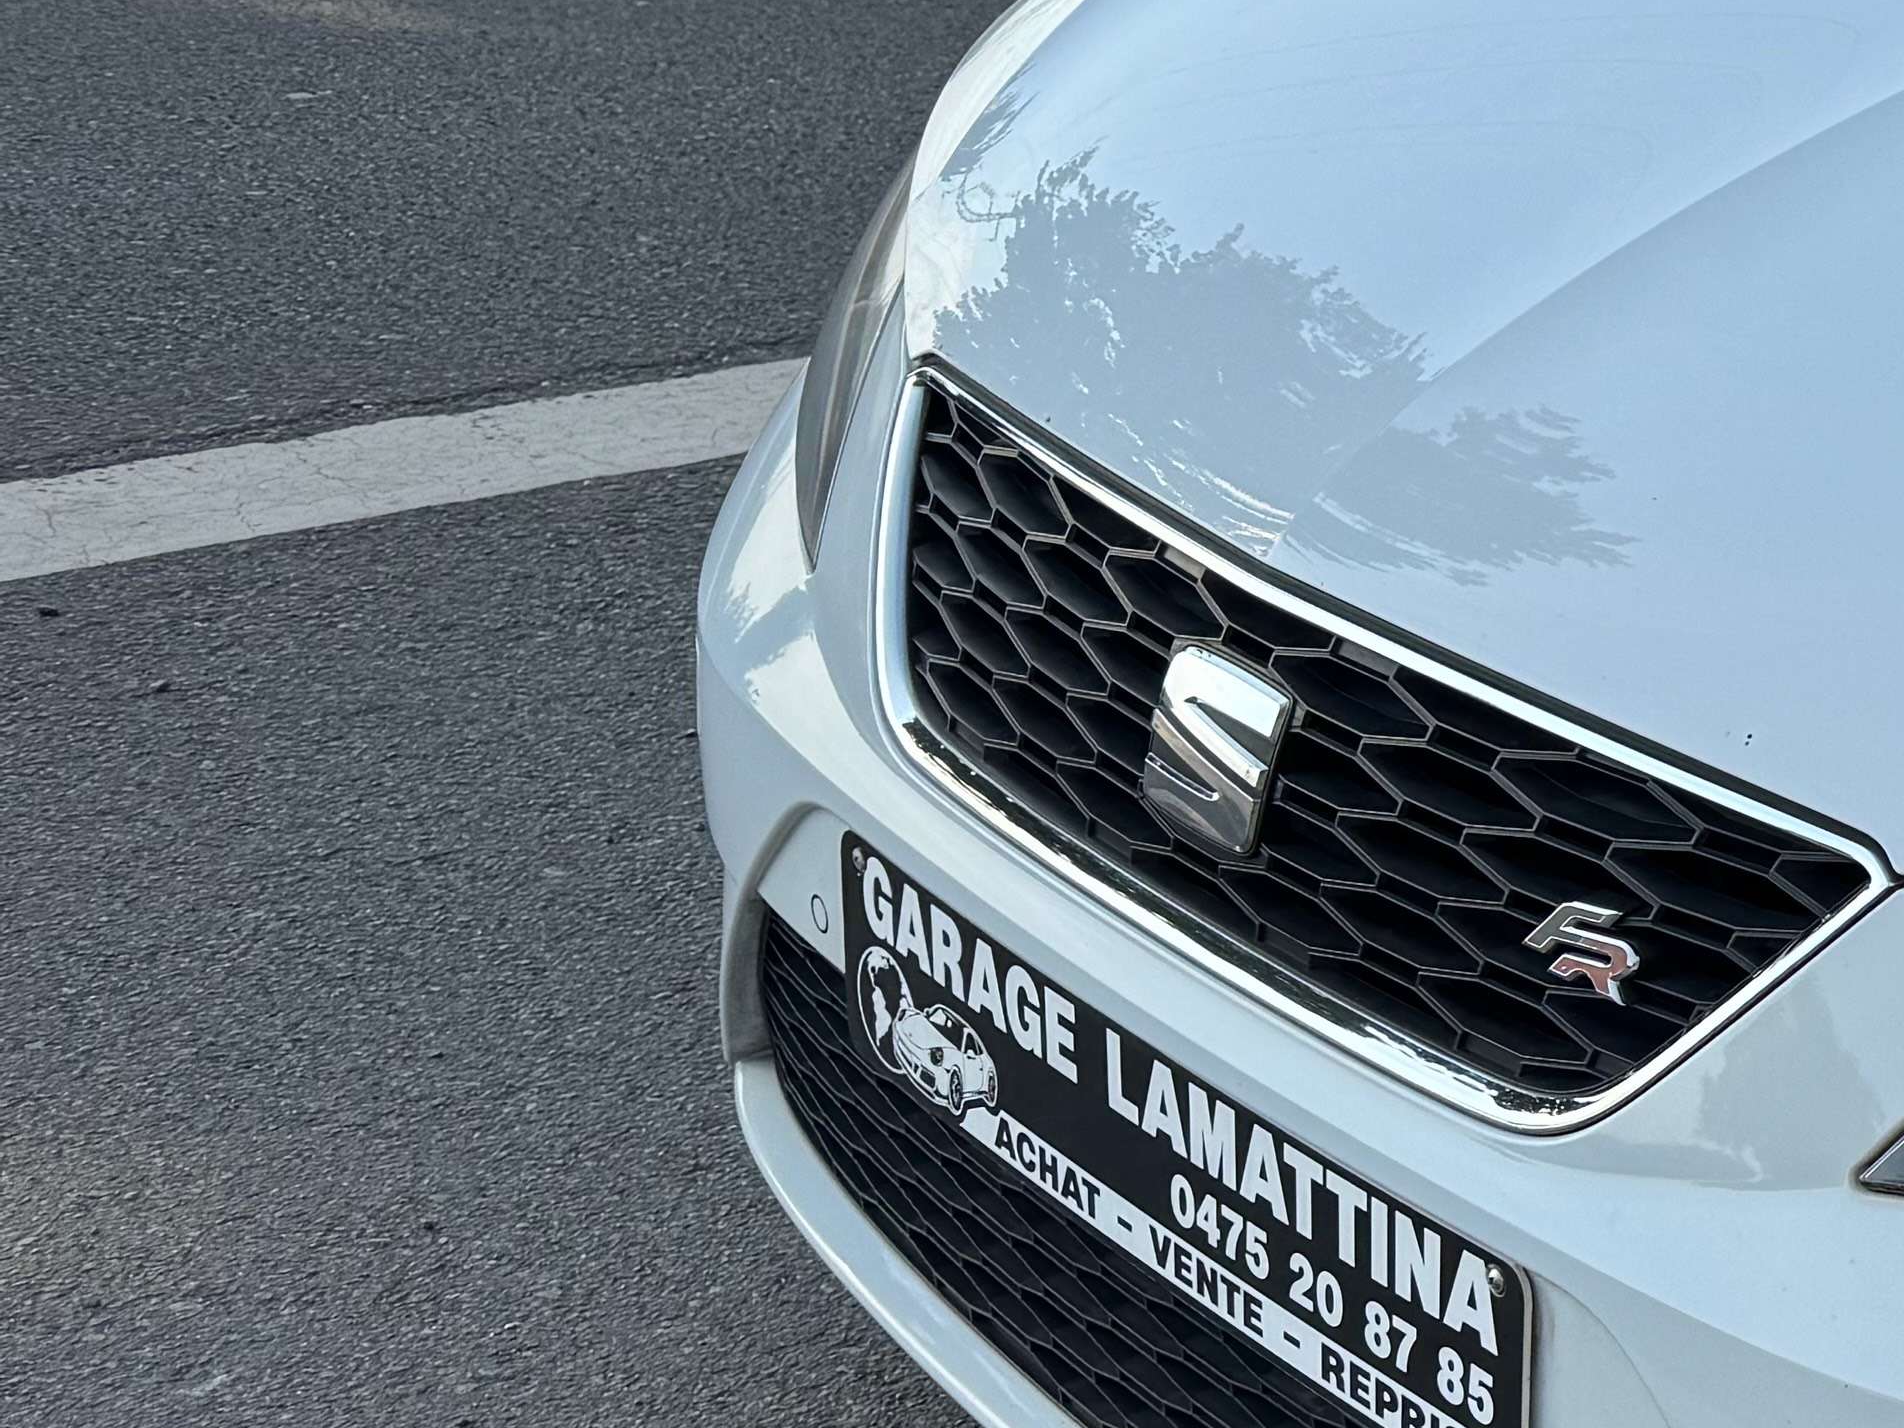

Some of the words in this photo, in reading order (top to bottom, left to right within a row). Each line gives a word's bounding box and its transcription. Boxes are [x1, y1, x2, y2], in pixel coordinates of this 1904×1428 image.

[1522, 901, 1640, 1006] FR
[862, 856, 1078, 1084] GARAGE
[1105, 1027, 1498, 1356] LAMATTINA
[995, 1117, 1101, 1220] ACHAT
[1149, 1224, 1264, 1337] VENTE
[1171, 1174, 1269, 1280] 0475
[1289, 1253, 1343, 1328] 20
[1364, 1300, 1417, 1372] 87
[1437, 1347, 1494, 1426] 85
